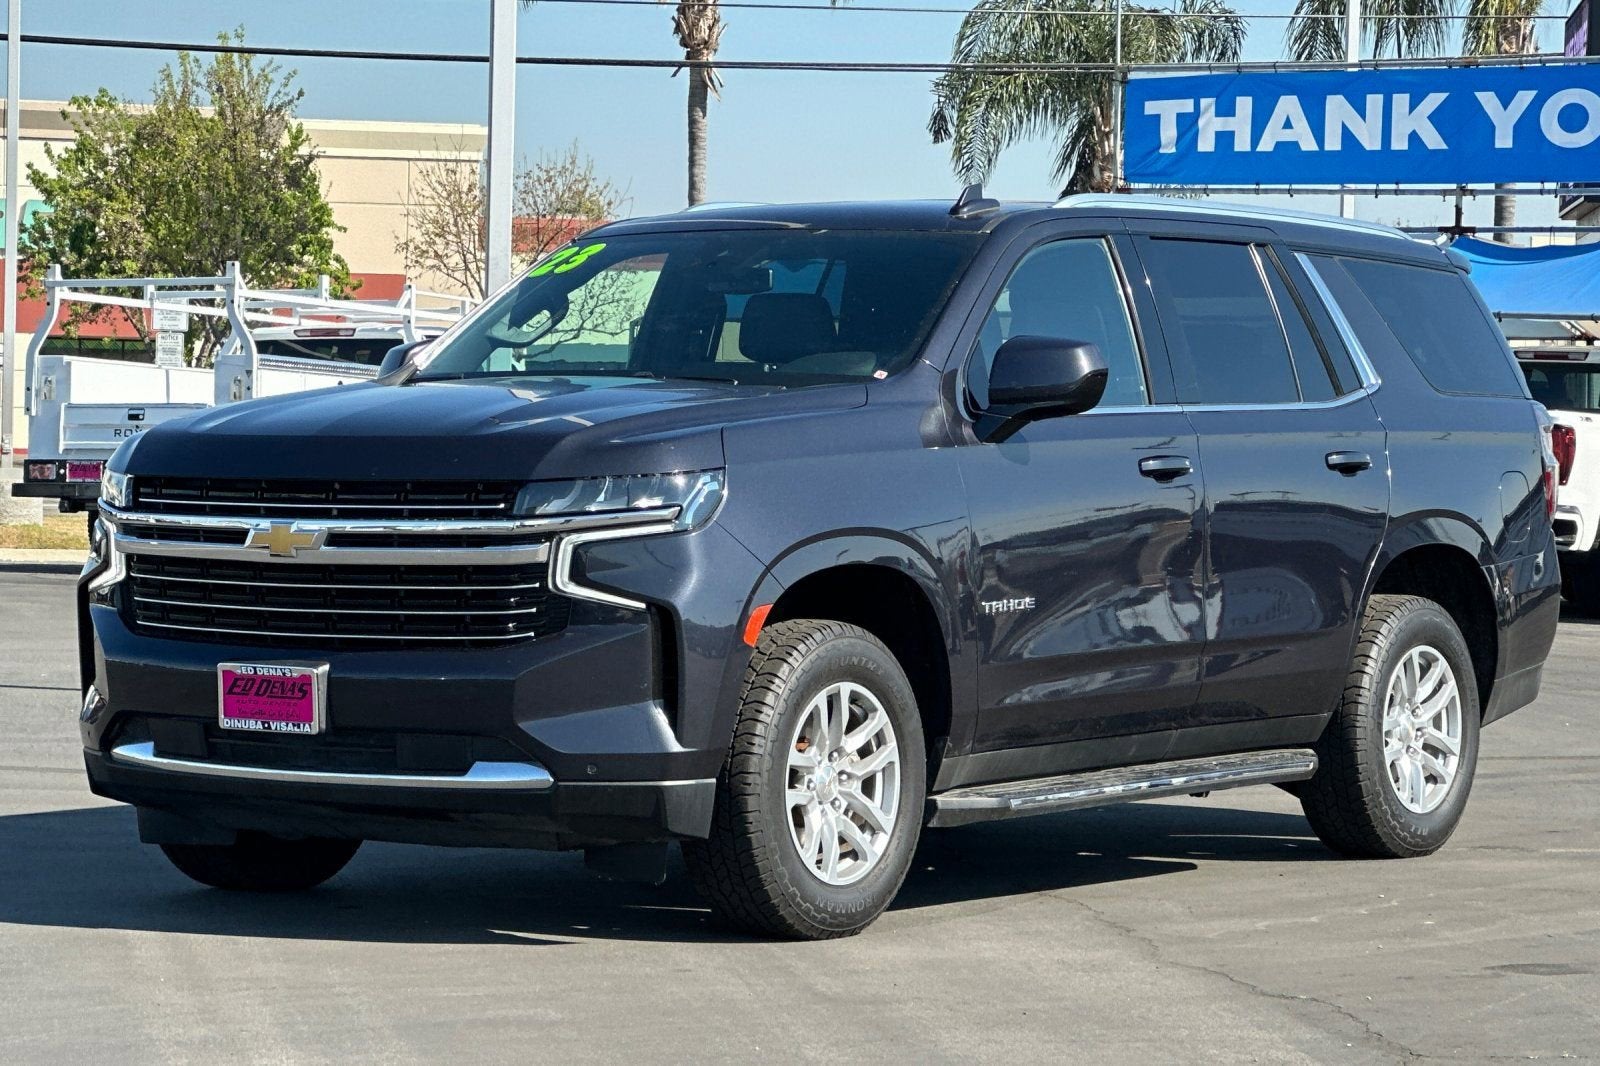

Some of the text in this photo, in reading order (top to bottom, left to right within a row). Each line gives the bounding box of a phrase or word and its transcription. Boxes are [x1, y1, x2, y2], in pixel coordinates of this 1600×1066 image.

[1144, 87, 1600, 154] THANK YO
[528, 243, 607, 278] 23
[981, 597, 1036, 614] TAHOE
[242, 666, 292, 677] ED DENA'S
[226, 677, 256, 696] ED
[223, 718, 311, 733] DINUBA VISALIA
